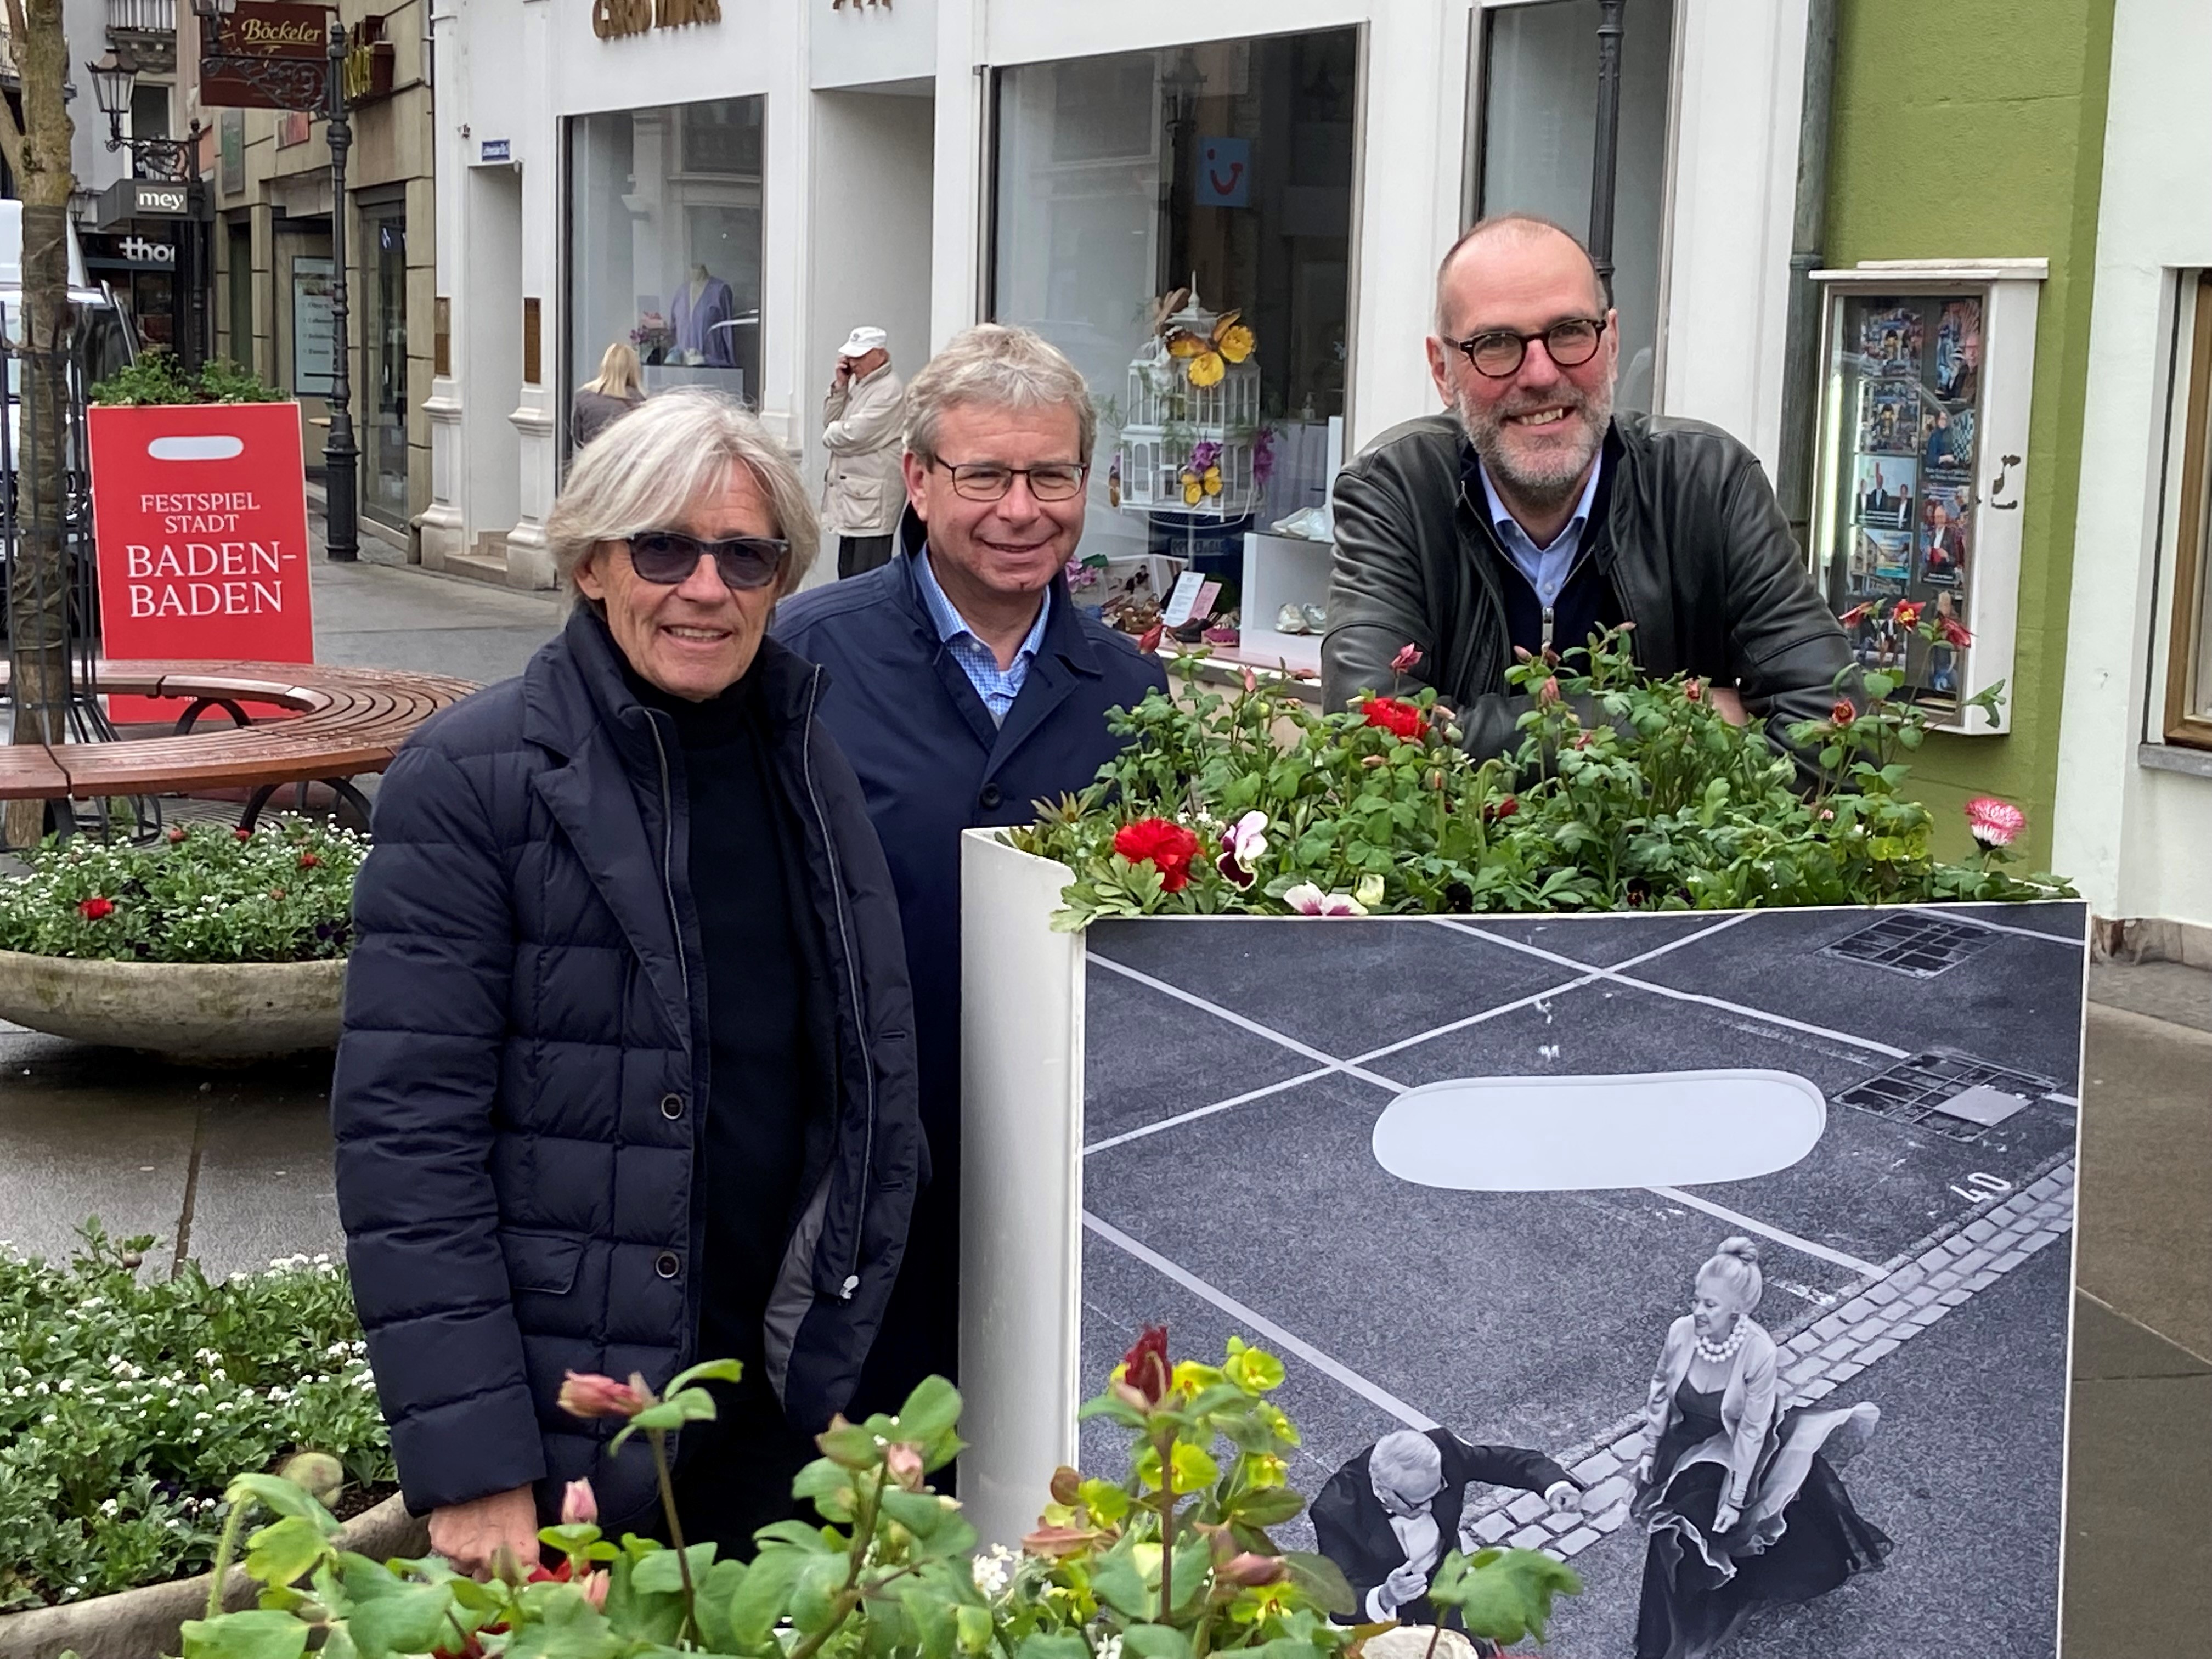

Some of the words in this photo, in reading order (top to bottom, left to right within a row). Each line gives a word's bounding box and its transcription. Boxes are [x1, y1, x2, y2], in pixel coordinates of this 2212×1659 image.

[241, 18, 322, 42] Böckeler
[139, 193, 184, 210] mey
[140, 493, 261, 513] FESTSPIEL
[165, 514, 240, 534] STADT
[126, 541, 297, 578] BADEN-
[129, 580, 284, 618] BADEN
[1950, 1172, 2012, 1203] 40
